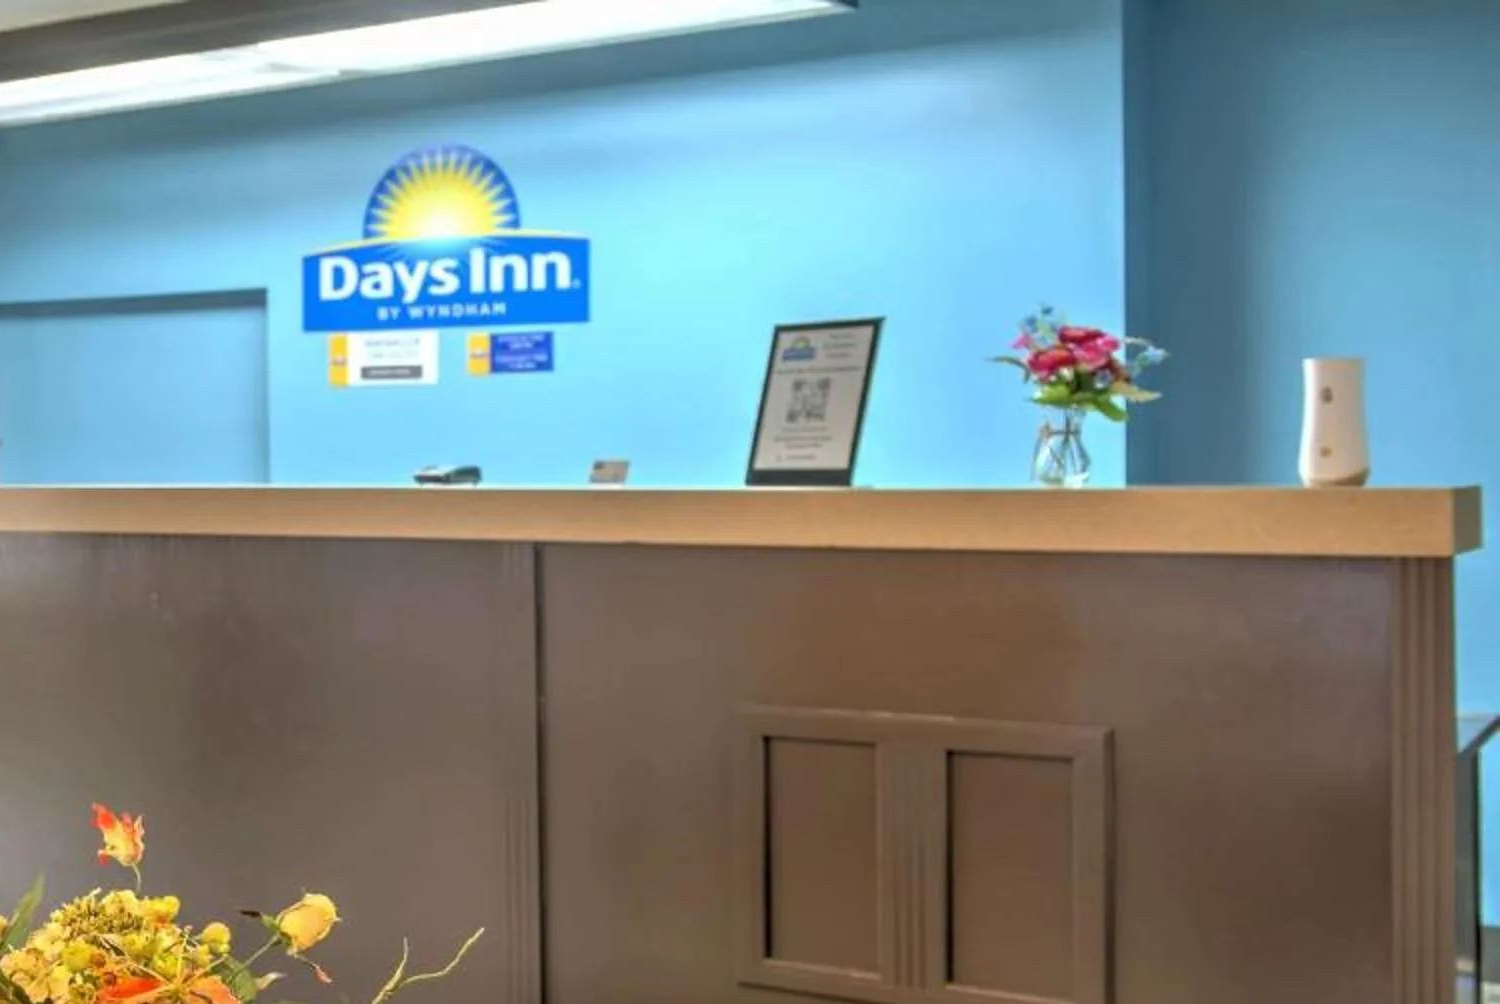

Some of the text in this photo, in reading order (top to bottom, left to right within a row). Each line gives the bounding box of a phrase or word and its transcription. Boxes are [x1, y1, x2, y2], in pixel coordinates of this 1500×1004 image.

[318, 247, 572, 304] Days Inn
[376, 301, 508, 321] BY WYNDHAM
